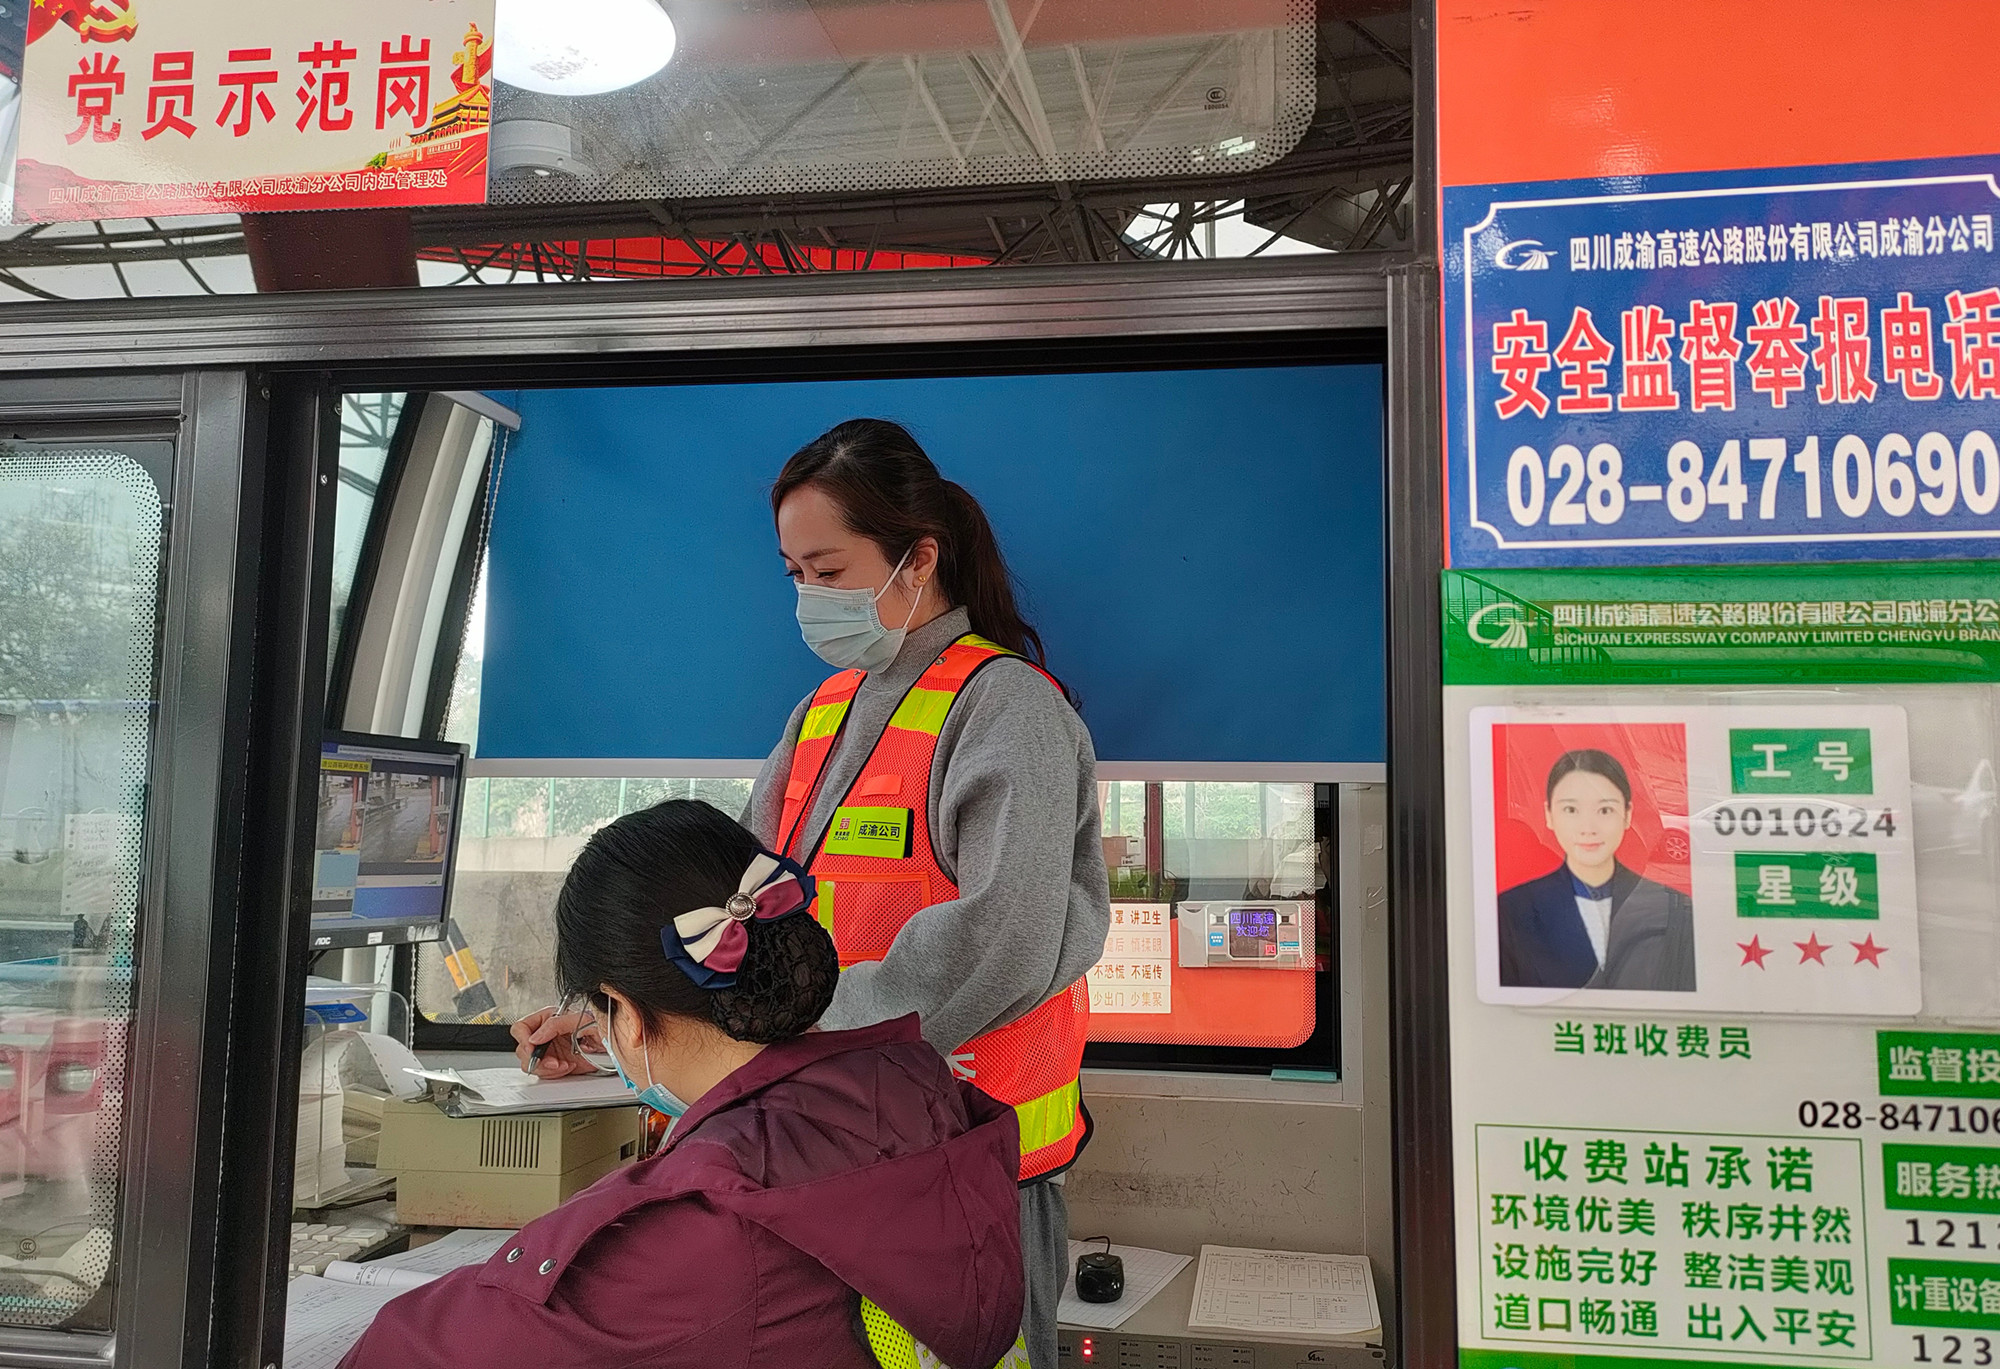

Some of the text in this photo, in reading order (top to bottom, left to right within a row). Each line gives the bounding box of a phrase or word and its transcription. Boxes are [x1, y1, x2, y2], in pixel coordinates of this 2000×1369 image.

[65, 36, 432, 145] 党员示范岗
[48, 170, 449, 205] 四川成渝高速公路股份有限公司成渝分公司内江管理处
[1570, 214, 1994, 271] 四川成渝高速公路股份有限公司成渝分公司
[1492, 287, 2000, 419] 安全监督举报电话
[1507, 429, 2000, 528] 028-84710690
[1553, 599, 2000, 627] 四川成渝高速公路股份有限公司成渝分公
[1554, 633, 1622, 646] SICHUAN
[1623, 632, 1726, 645] EXPRESSWAY
[1730, 631, 1809, 645] COMPANY
[1812, 631, 1875, 643] LIMITED
[1878, 629, 1955, 643] CHENGYU
[1750, 741, 1854, 782] 工号
[859, 824, 900, 838] 成渝公司
[1714, 806, 1897, 838] 0010624
[1756, 865, 1861, 906] 星级
[1130, 910, 1162, 925] 讲卫生
[1230, 912, 1276, 926] 四川高速
[315, 937, 331, 945] AOC
[1093, 964, 1163, 980] 不恐慌 不谣传
[1093, 991, 1124, 1007] 少出门
[1554, 1021, 1752, 1060] 当班收费员
[1889, 1046, 2000, 1084] 监督投
[1524, 1136, 1814, 1193] 收费站承诺
[1896, 1161, 2000, 1199] 服务热
[1491, 1193, 1852, 1244] 环境优美 秩序井然
[1906, 1217, 2000, 1250] 121
[1492, 1242, 1855, 1296] 设施完好 整洁美观
[1894, 1273, 2000, 1314] 计重设备
[1494, 1293, 1857, 1348] 道口畅通 出入平安
